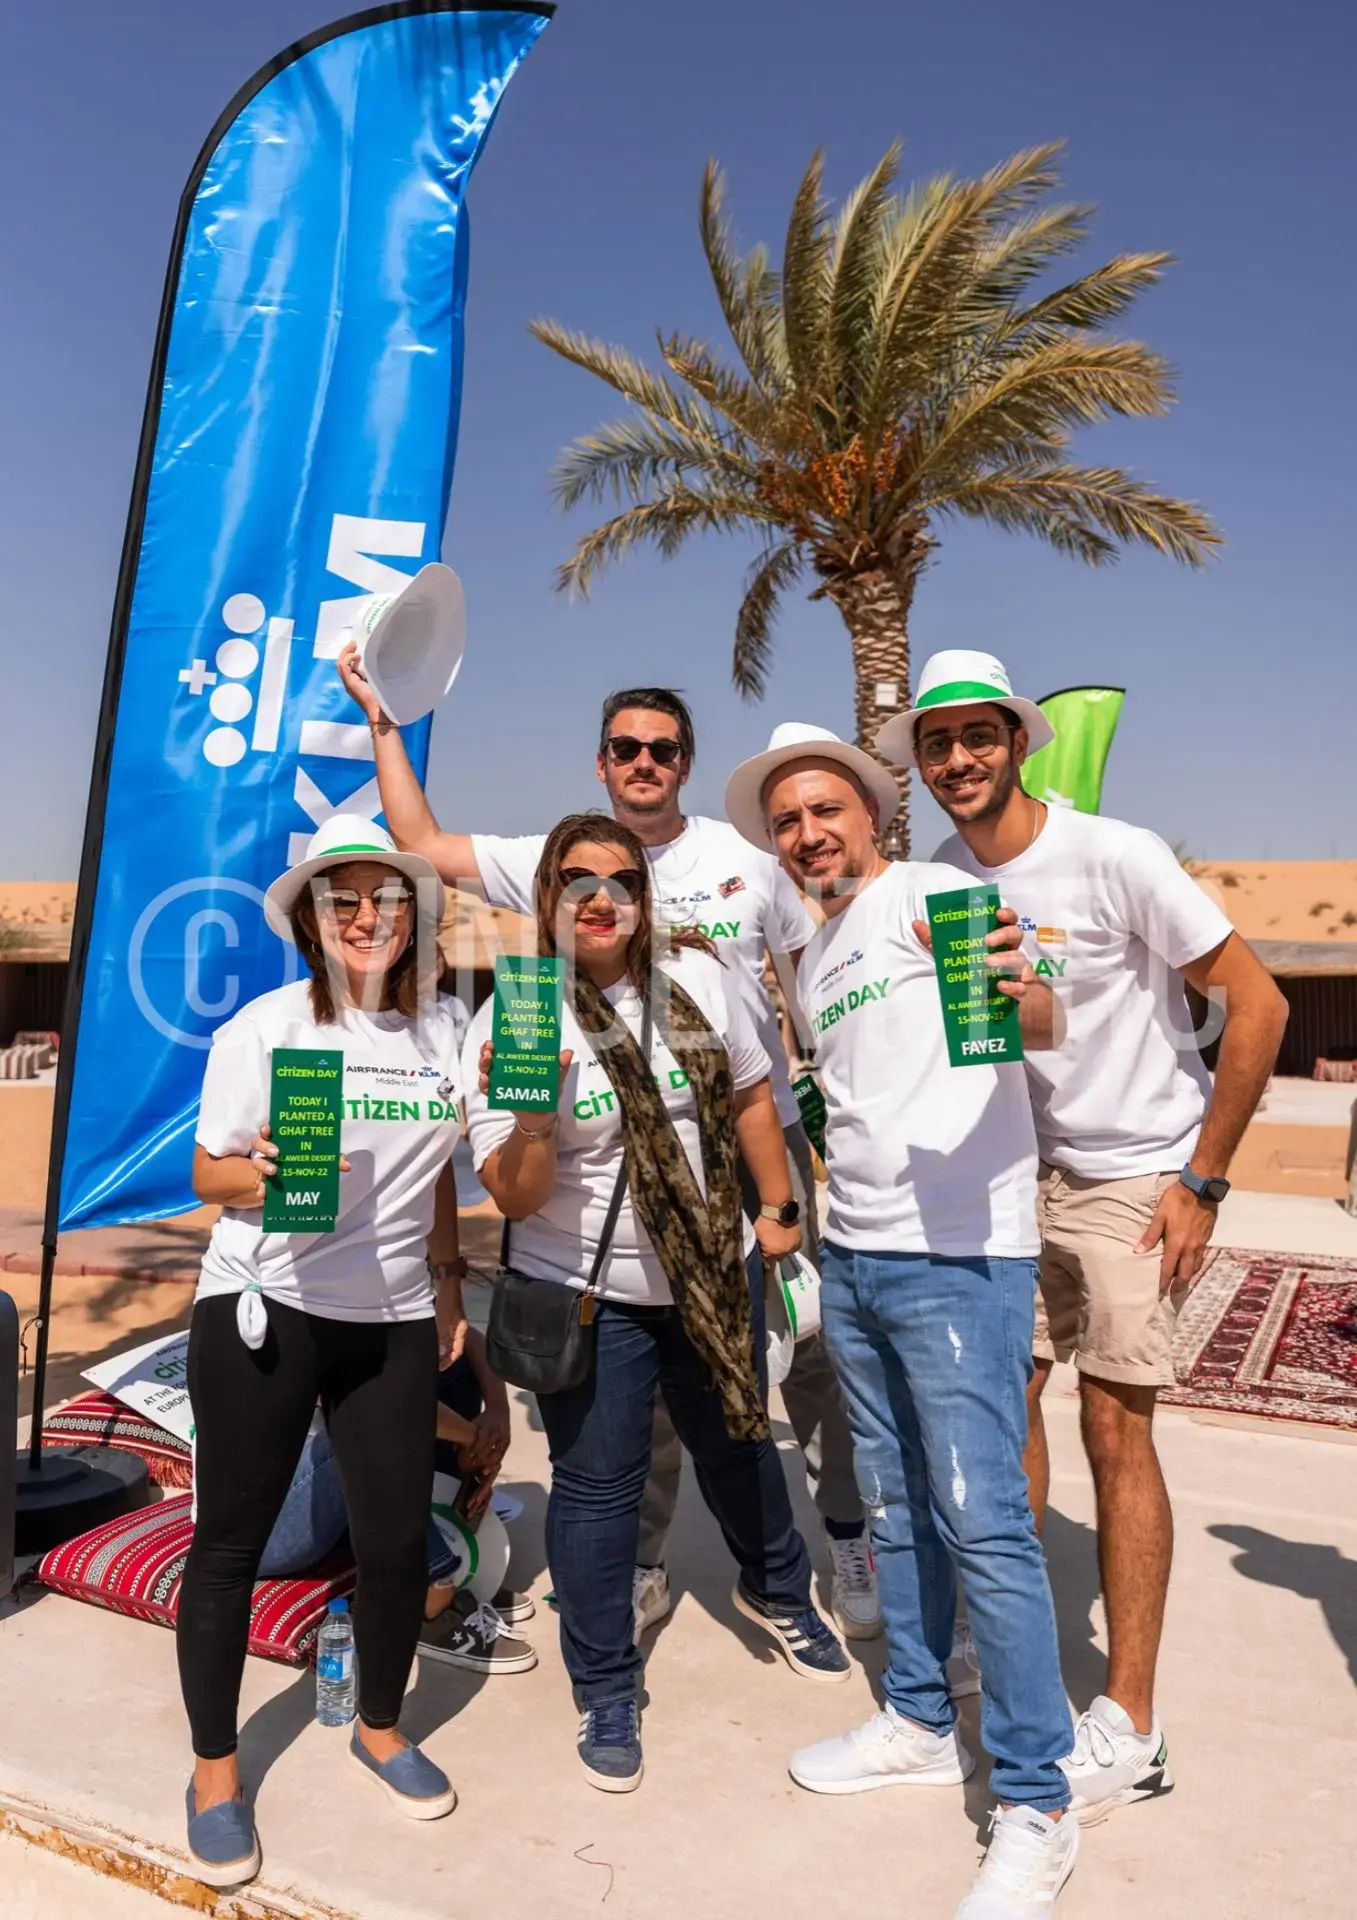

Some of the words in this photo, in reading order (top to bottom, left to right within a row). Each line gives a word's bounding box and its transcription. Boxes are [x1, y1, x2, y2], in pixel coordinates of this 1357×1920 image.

[973, 905, 997, 918] DAY
[948, 937, 985, 951] TODAY
[1034, 958, 1067, 977] AY
[538, 975, 560, 985] DAY
[946, 970, 975, 983] GHAF
[847, 977, 890, 1012] DAY
[970, 985, 982, 996] IN
[511, 1000, 542, 1010] TODAY
[948, 1002, 957, 1010] AL
[501, 1012, 545, 1023] PLANTED
[548, 1016, 556, 1024] A
[500, 1026, 528, 1036] GHAF
[531, 1028, 555, 1037] TREE
[521, 1041, 532, 1050] IN
[961, 1037, 1007, 1056] FAYEZ
[506, 1053, 530, 1061] AWEER
[531, 1054, 556, 1062] DESERT
[317, 1069, 338, 1078] DAY
[346, 1065, 408, 1077] AIRFRANCE
[503, 1065, 548, 1075] 15-NOV-22
[495, 1086, 550, 1102] SAMAR
[288, 1096, 321, 1106] TODAY
[279, 1111, 325, 1121] PLANTED
[327, 1111, 335, 1121] A
[278, 1126, 307, 1136] GHAF
[309, 1126, 334, 1136] TREE
[300, 1141, 312, 1151] IN
[285, 1154, 311, 1162] AWEER
[311, 1154, 336, 1162] DESERT
[282, 1168, 328, 1176] 15-NOV-22
[285, 1191, 320, 1206] MAY
[143, 1395, 157, 1406] AT
[155, 1387, 174, 1399] THE
